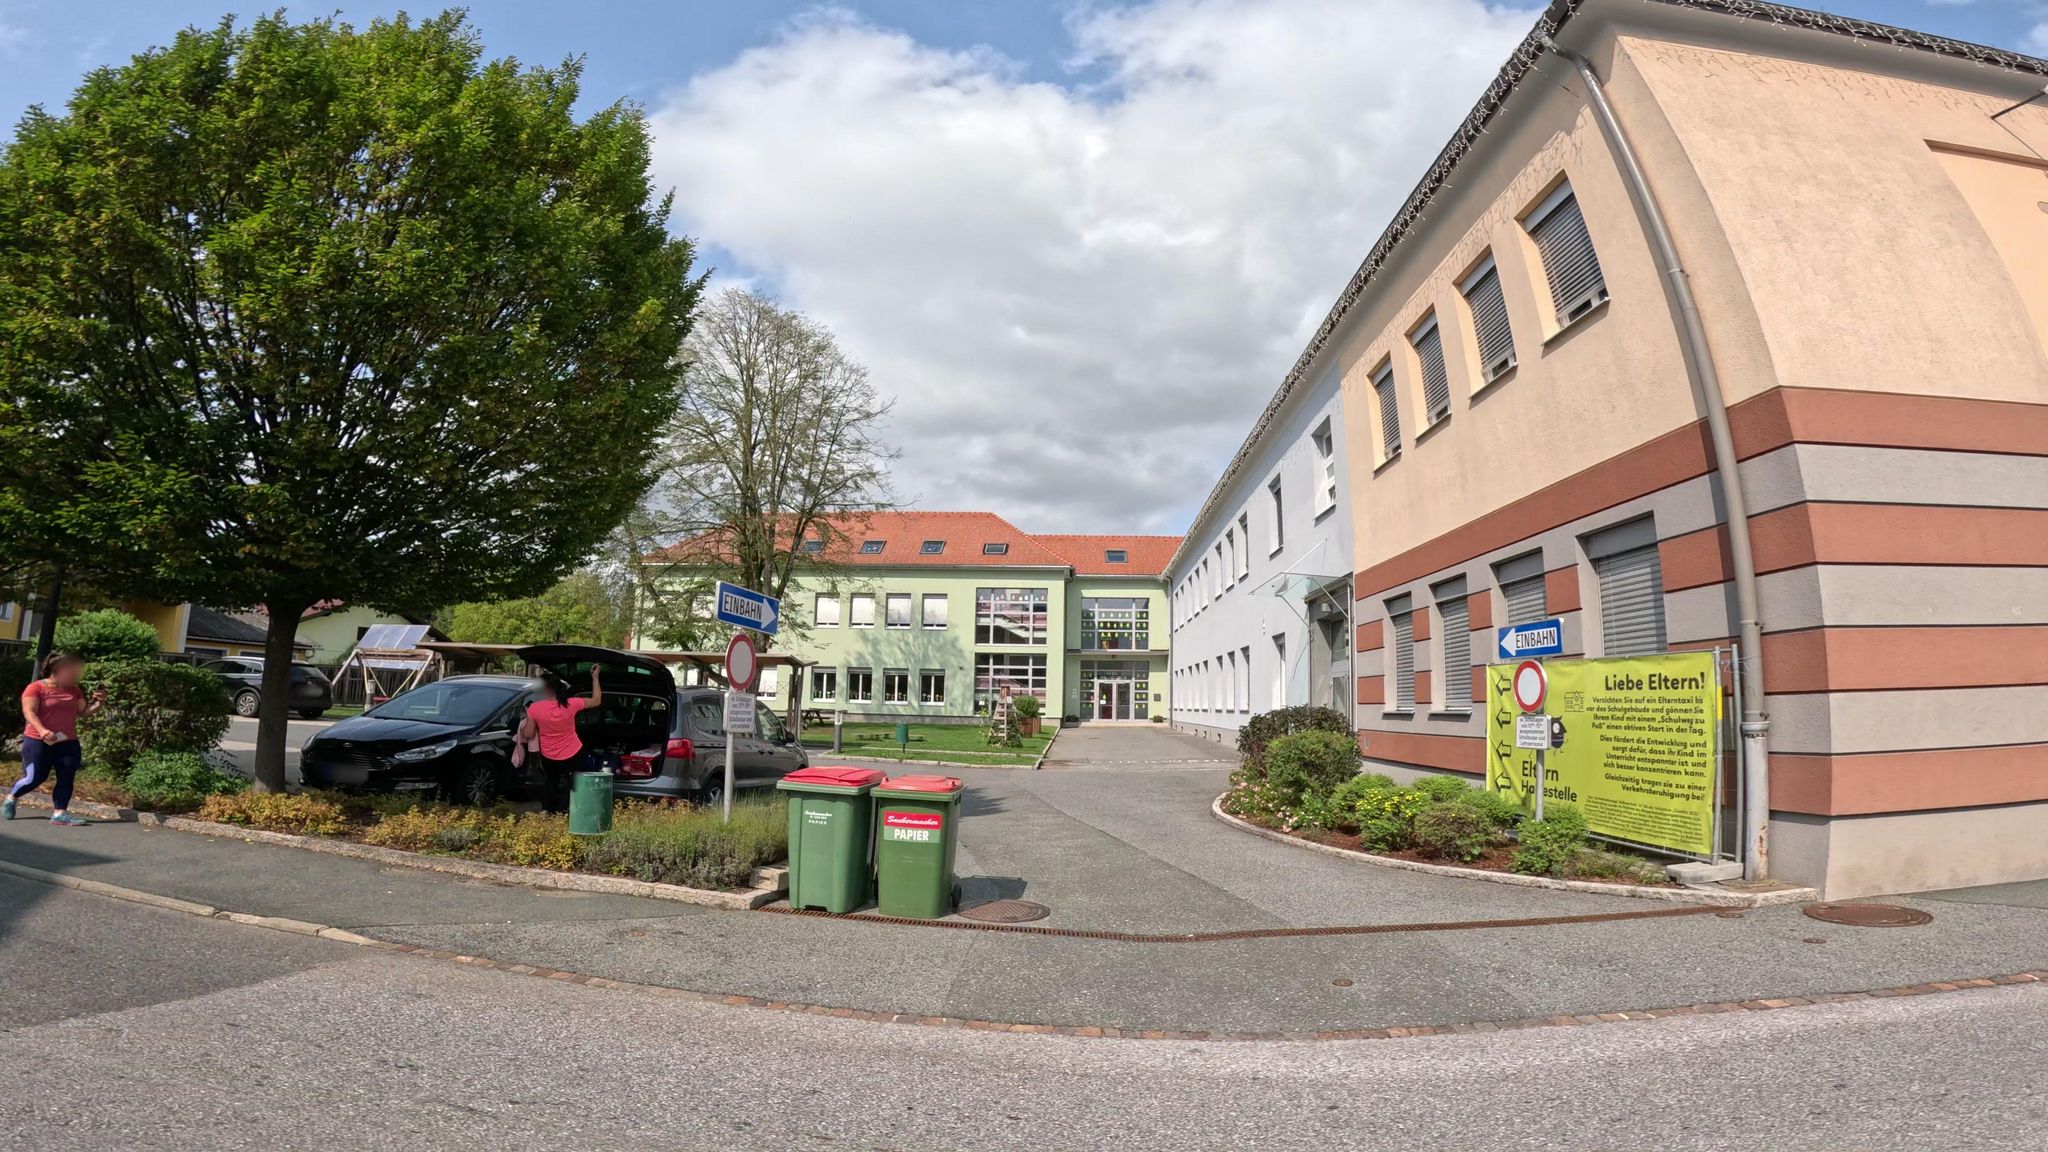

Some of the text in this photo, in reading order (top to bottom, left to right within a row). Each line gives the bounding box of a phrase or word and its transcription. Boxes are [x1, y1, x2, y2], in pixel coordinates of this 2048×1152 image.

[724, 594, 762, 620] EINBAHN
[1516, 629, 1555, 648] EINBAHN
[1605, 671, 1705, 691] Liebe Eltern!
[1634, 696, 1645, 704] auf
[1658, 696, 1693, 704] Elterntaxi
[1607, 705, 1650, 715] Schulgebäude
[1665, 706, 1693, 716] gönnen
[1694, 706, 1704, 714] Sie
[1637, 715, 1656, 723] einem
[1624, 723, 1646, 731] aktiven
[1648, 724, 1664, 732] Start
[1666, 725, 1673, 733] in
[1613, 735, 1634, 744] fördert
[1636, 736, 1646, 744] die
[1647, 738, 1687, 749] Entwicklung
[1629, 746, 1647, 755] dafür,
[1606, 753, 1707, 768] Unterricht entspannter ist und
[1522, 760, 1558, 781] Eltrn
[1616, 762, 1635, 771] besser
[1636, 764, 1682, 776] konzentrieren
[1684, 769, 1707, 777] kann.
[1605, 773, 1640, 785] Gleichzeitig
[1641, 778, 1662, 787] tragen
[1663, 780, 1673, 788] sie
[1688, 783, 1706, 791] einer
[1522, 780, 1577, 802] Haestelle
[1622, 784, 1690, 801] Verkehrsberuhigung
[894, 829, 929, 841] PAPIER
